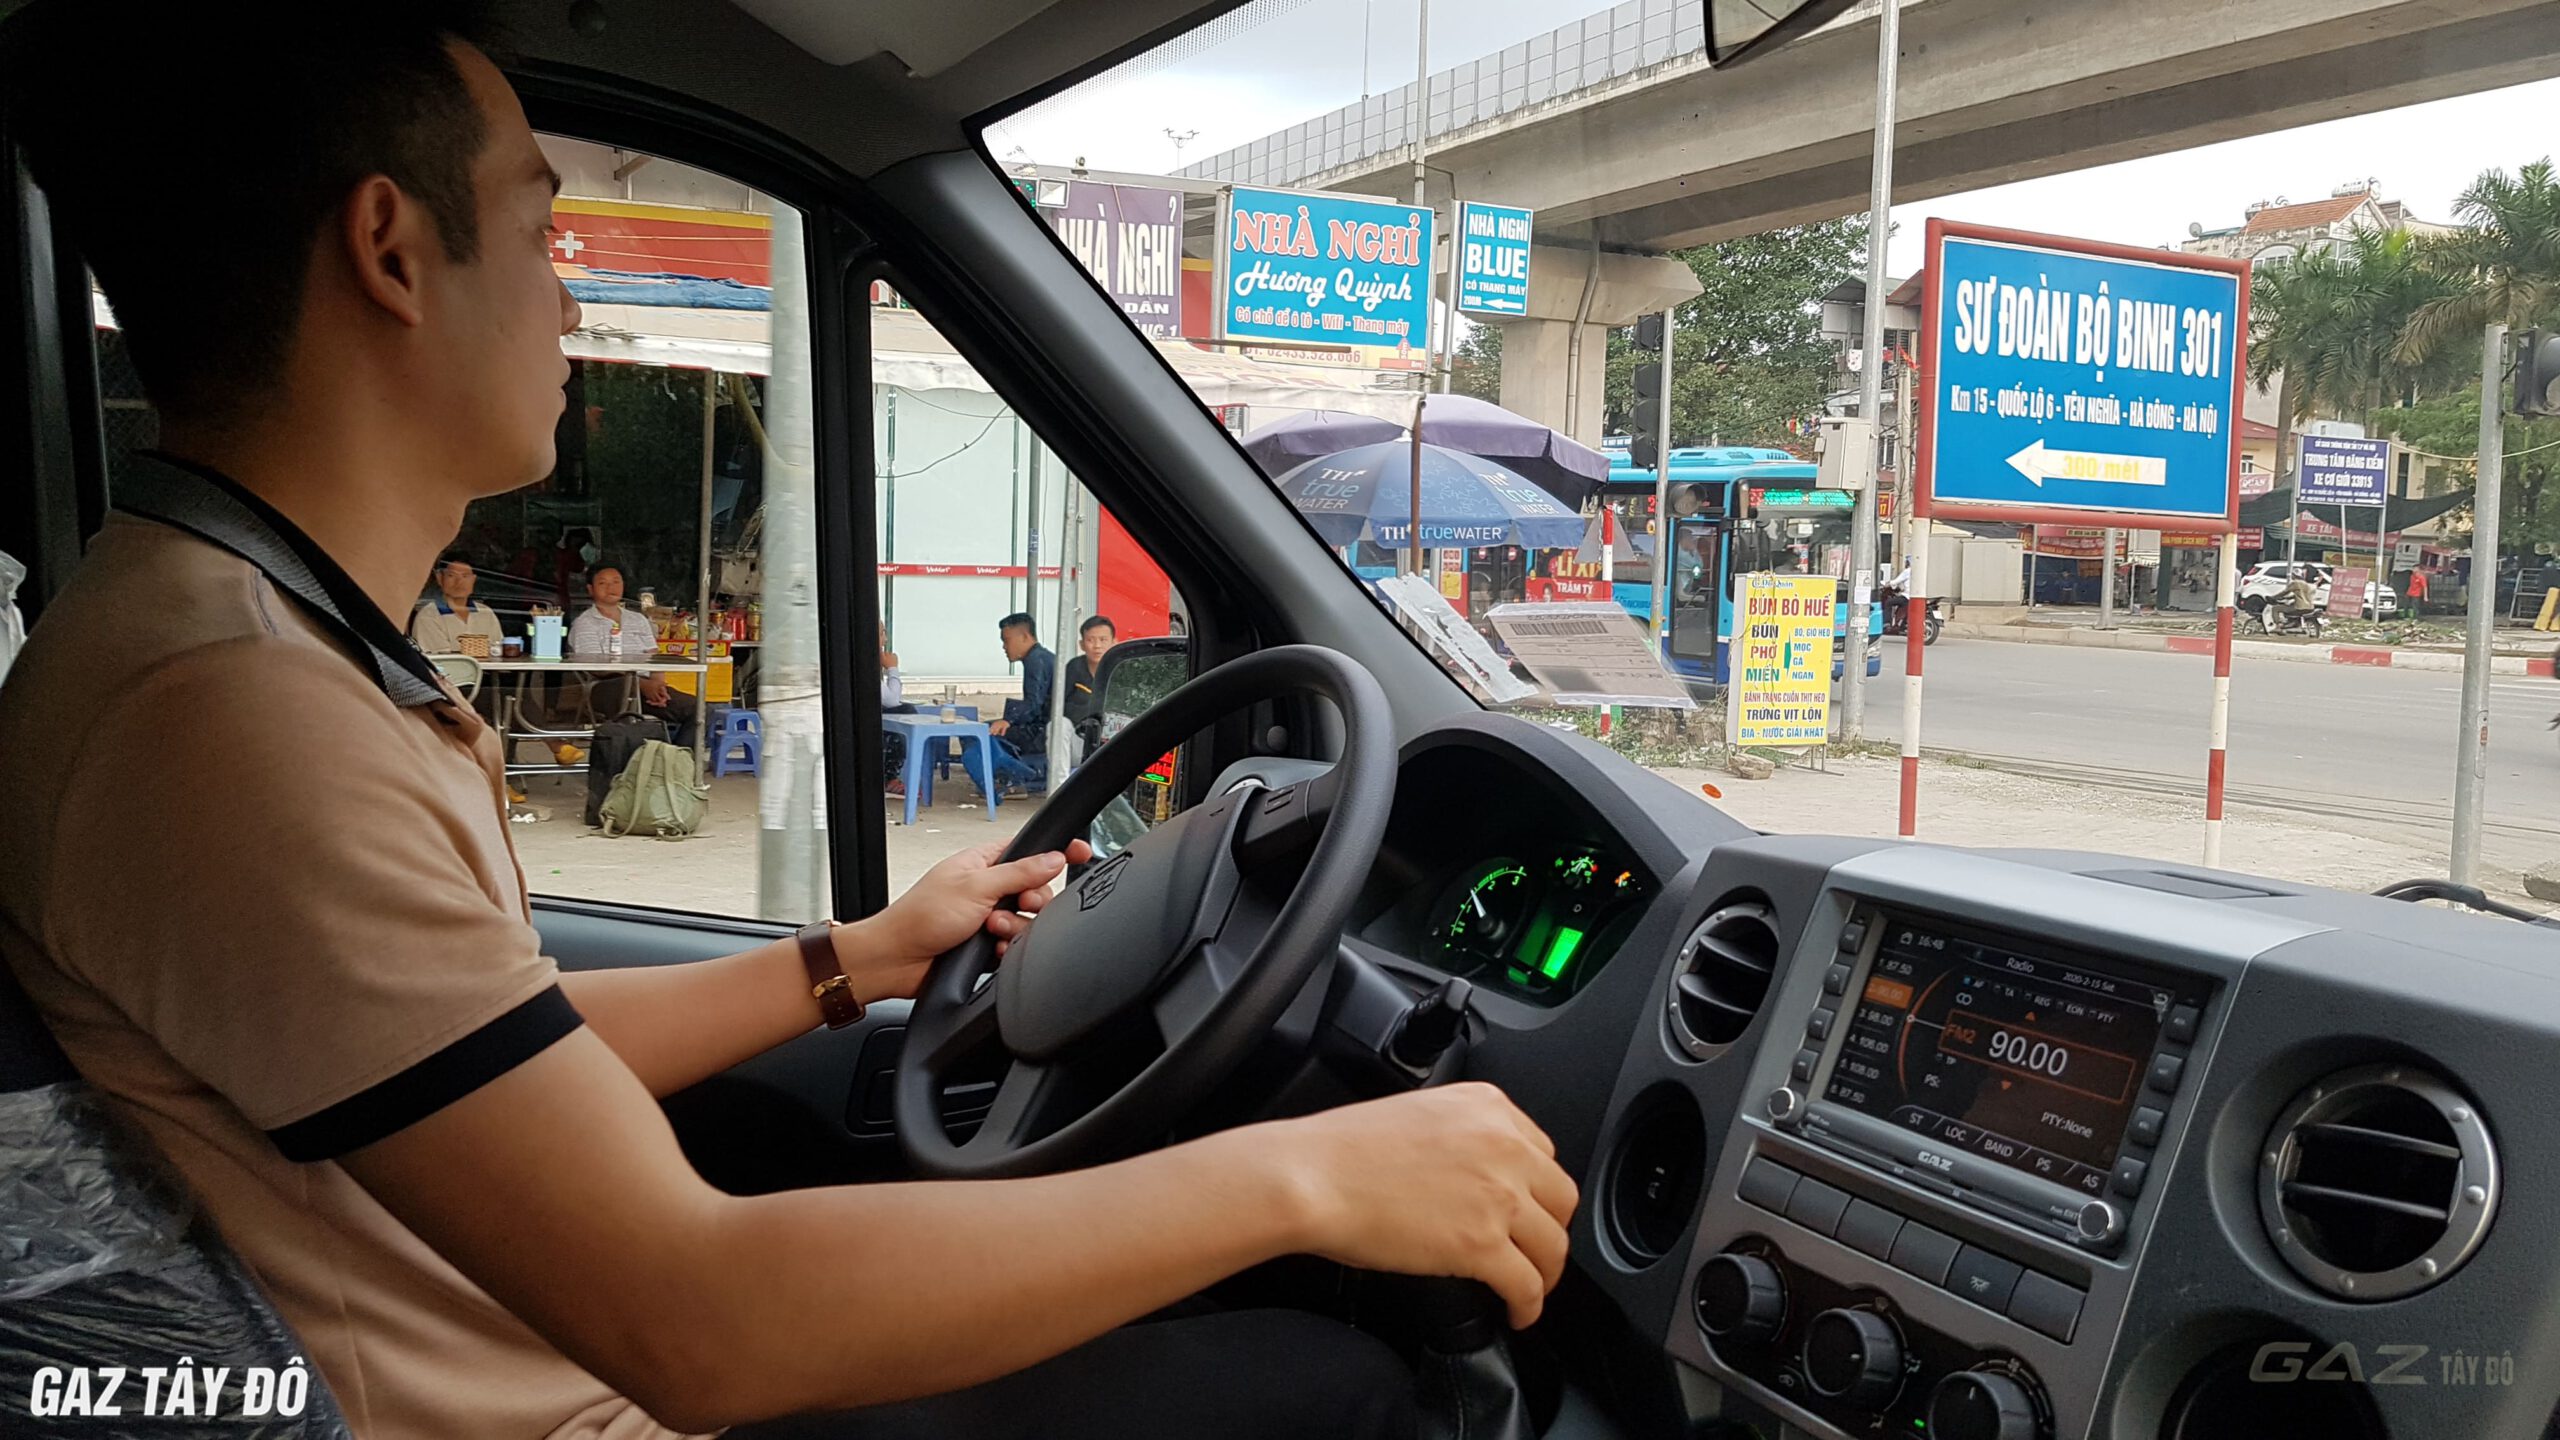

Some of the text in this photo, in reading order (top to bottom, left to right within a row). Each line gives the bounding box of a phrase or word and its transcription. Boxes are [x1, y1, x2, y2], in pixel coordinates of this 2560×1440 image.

[1468, 211, 1529, 241] NHÀ NGHỈ
[1233, 206, 1420, 266] NHÀ NGHỈ
[1117, 196, 1176, 296] NGHỈ
[1466, 243, 1526, 279] BLUE
[1234, 260, 1412, 311] Hương Quỳnh
[1465, 280, 1526, 296] CÓ THANG MÁY
[1235, 306, 1250, 323] Có
[1253, 307, 1273, 324] chỗ
[1276, 308, 1291, 327] để
[1292, 312, 1299, 327] ô
[1322, 314, 1344, 331] Wifi
[1352, 316, 1384, 334] Thang
[1386, 318, 1409, 336] máy
[1954, 273, 2222, 382] SƯ ĐOÀN BỘ BINH 301
[1951, 385, 1970, 412] Km
[1974, 388, 1989, 413] 15
[1997, 381, 2028, 419] QUỐC
[2030, 387, 2044, 424] LỘ
[2046, 394, 2054, 419] 6
[2063, 391, 2085, 423] YÊN
[2087, 394, 2121, 425] NGHĨA
[2129, 396, 2145, 428] HÀ
[2146, 398, 2174, 430] ĐÔNG
[2183, 401, 2197, 432] HÀ
[2199, 403, 2219, 439] NỘI
[1320, 468, 1350, 480] TH
[2063, 455, 2139, 480] 300 mét
[1302, 479, 1361, 498] true
[1381, 526, 1404, 540] TH
[1749, 593, 1831, 616] BÚN BÒ HUẾ
[1751, 620, 1778, 638] BÚN
[1750, 641, 1777, 659] PHỞ
[1792, 671, 1814, 680] NGAN
[1744, 691, 1761, 702] BÁNH
[1800, 692, 1812, 704] THỊT
[1813, 693, 1825, 702] HEO
[1746, 706, 1821, 722] TRỨNG VỊT LỘN
[1741, 728, 1755, 738] BIA
[1762, 725, 1784, 738] NƯỚC
[1786, 725, 1802, 738] GIẢI
[1918, 935, 1944, 950] 16:48
[1886, 960, 1913, 975] 87.50
[2007, 957, 2034, 973] Radio
[2063, 971, 2114, 993] 2020-2-15 Sat
[2034, 996, 2050, 1007] REG
[2066, 1004, 2083, 1016] EON
[2097, 1012, 2114, 1024] PTY
[1948, 1024, 1976, 1044] FM2
[1988, 1031, 2067, 1075] 90.00
[1909, 1112, 1925, 1125] ST
[2040, 1112, 2093, 1138] PTY:None
[1945, 1124, 1966, 1142] LOC
[1984, 1139, 2014, 1158] BAND
[1918, 1150, 1953, 1173] GAZ
[2036, 1157, 2052, 1172] PS
[2082, 1174, 2099, 1188] AS
